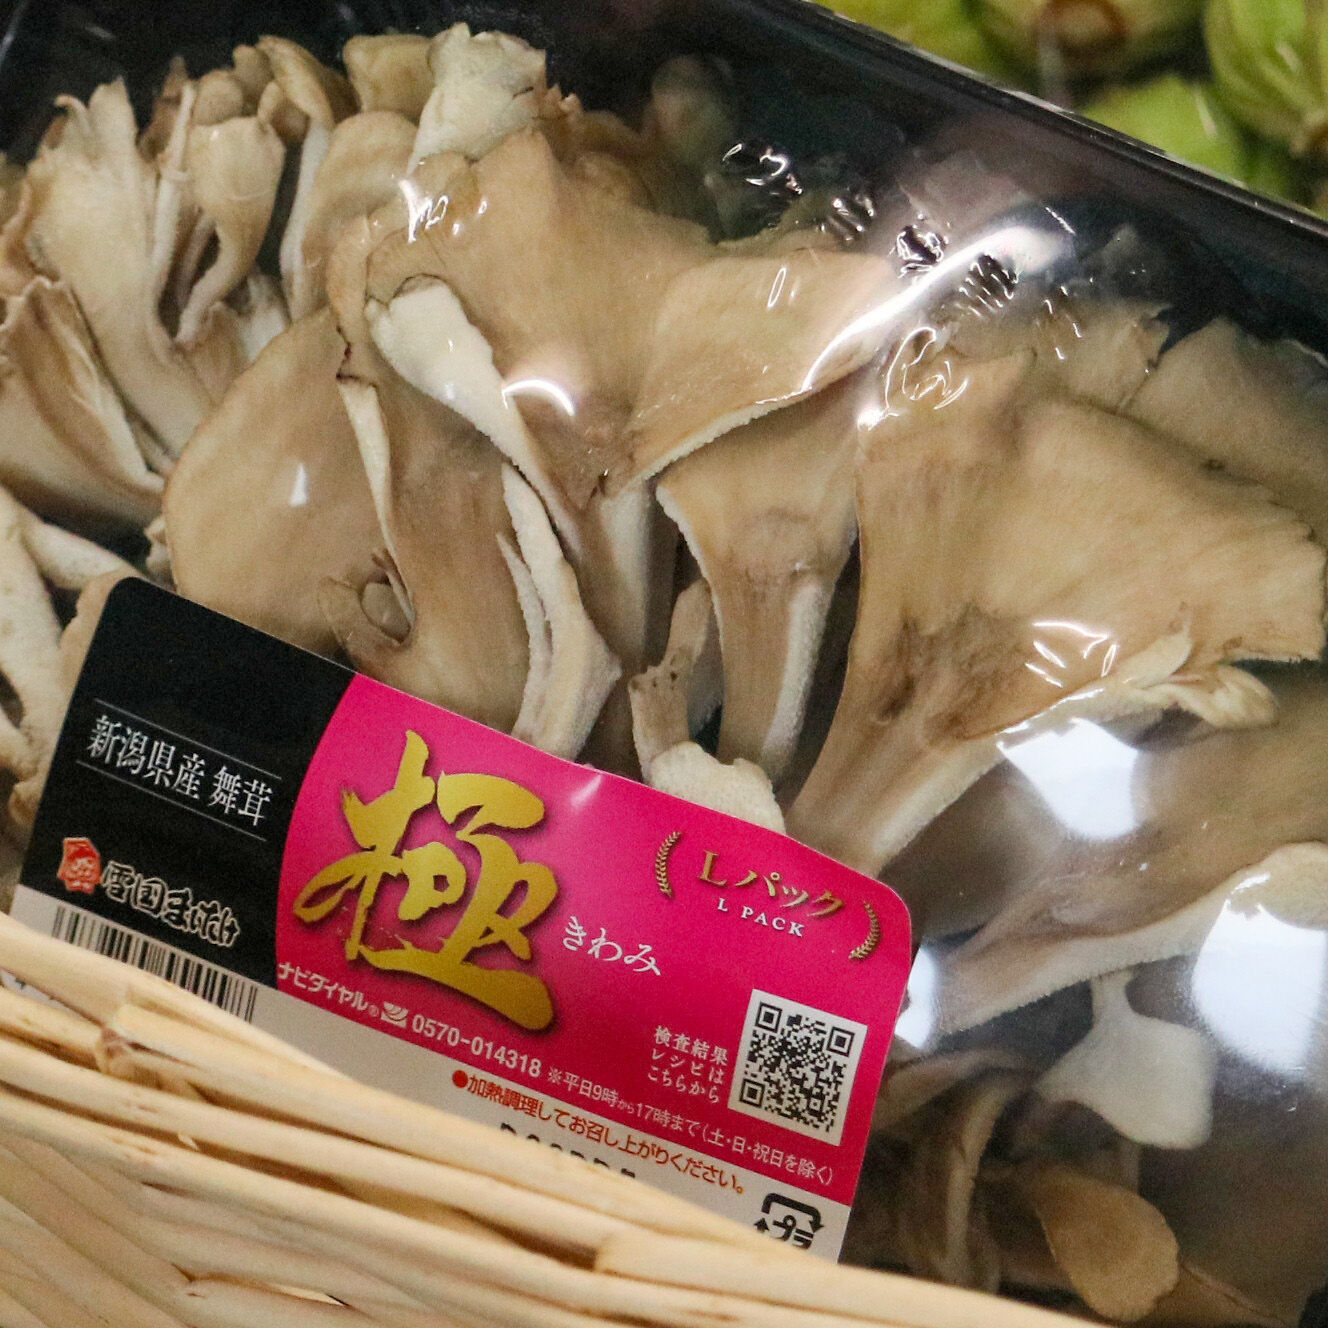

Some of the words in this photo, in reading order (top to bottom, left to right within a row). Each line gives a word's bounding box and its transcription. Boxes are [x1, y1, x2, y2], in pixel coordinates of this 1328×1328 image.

[87, 713, 206, 801] 新潟県産
[207, 765, 274, 827] 舞茸
[292, 729, 559, 1031] 極
[697, 849, 847, 918] Lパック
[561, 914, 662, 977] きわみ
[717, 897, 729, 913] L
[741, 908, 807, 938] PACK
[411, 1013, 543, 1079] 0570-014318
[651, 1047, 725, 1085] レシピは
[653, 1025, 730, 1066] 検査結果
[647, 1065, 722, 1105] こちらから
